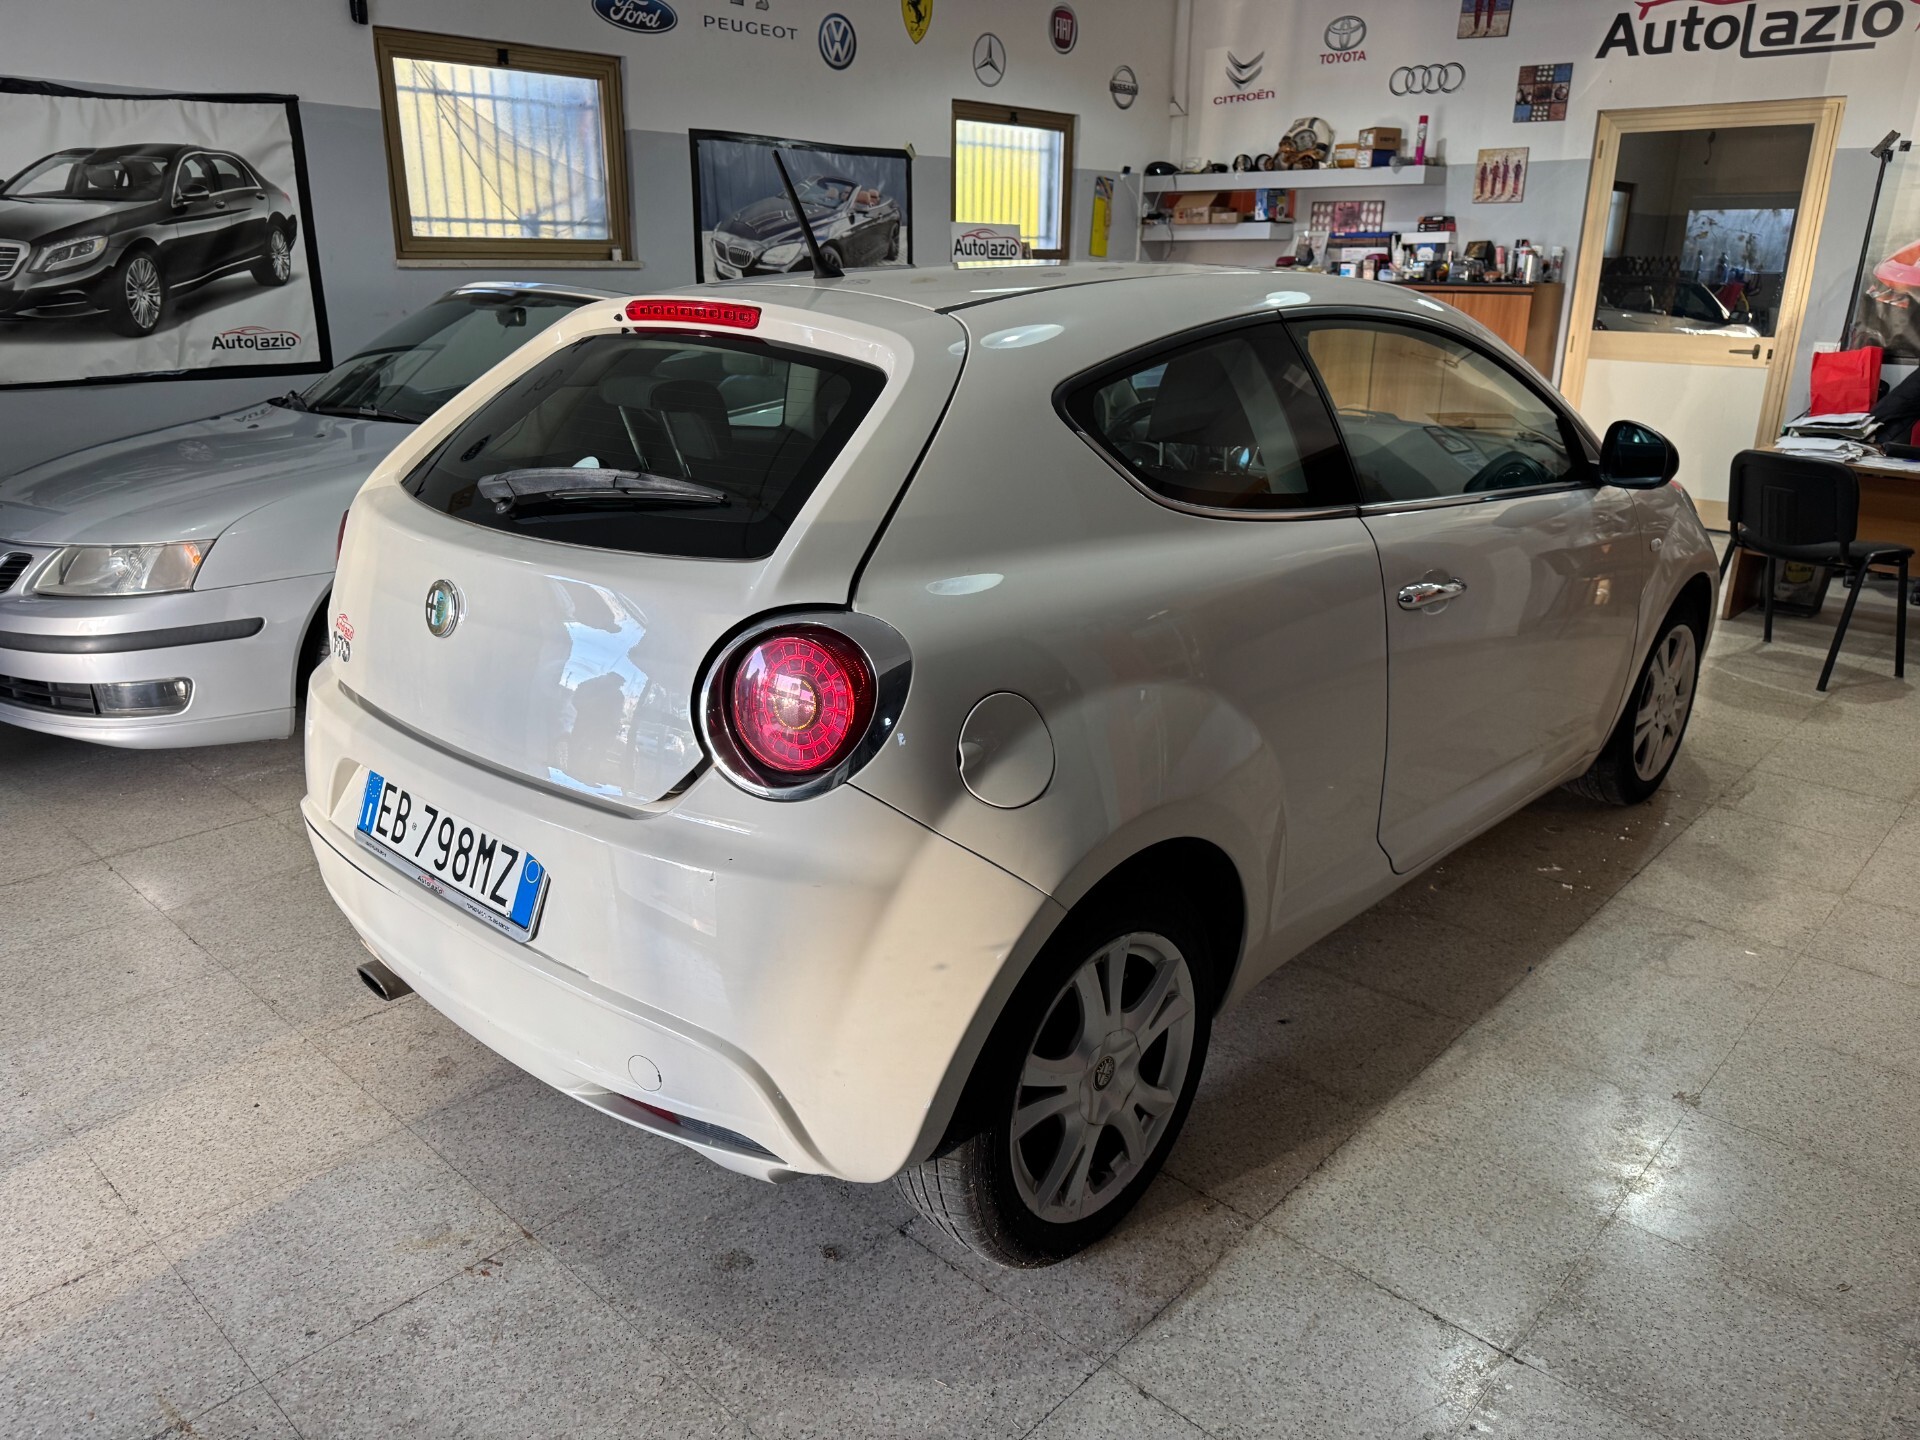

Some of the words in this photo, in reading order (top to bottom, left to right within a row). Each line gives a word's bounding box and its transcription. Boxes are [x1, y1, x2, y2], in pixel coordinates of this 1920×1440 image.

[610, 0, 661, 28] Ford
[703, 15, 798, 40] PEUGEOT
[1055, 16, 1073, 41] FIAT
[1595, 0, 1905, 58] AutoLazio
[1319, 50, 1367, 64] TOYOTA
[1111, 82, 1137, 94] NISSAN
[953, 238, 1018, 260] AutoLazio
[211, 333, 297, 351] AutoLazio
[376, 782, 412, 845] EB
[414, 804, 520, 908] 798MZ
